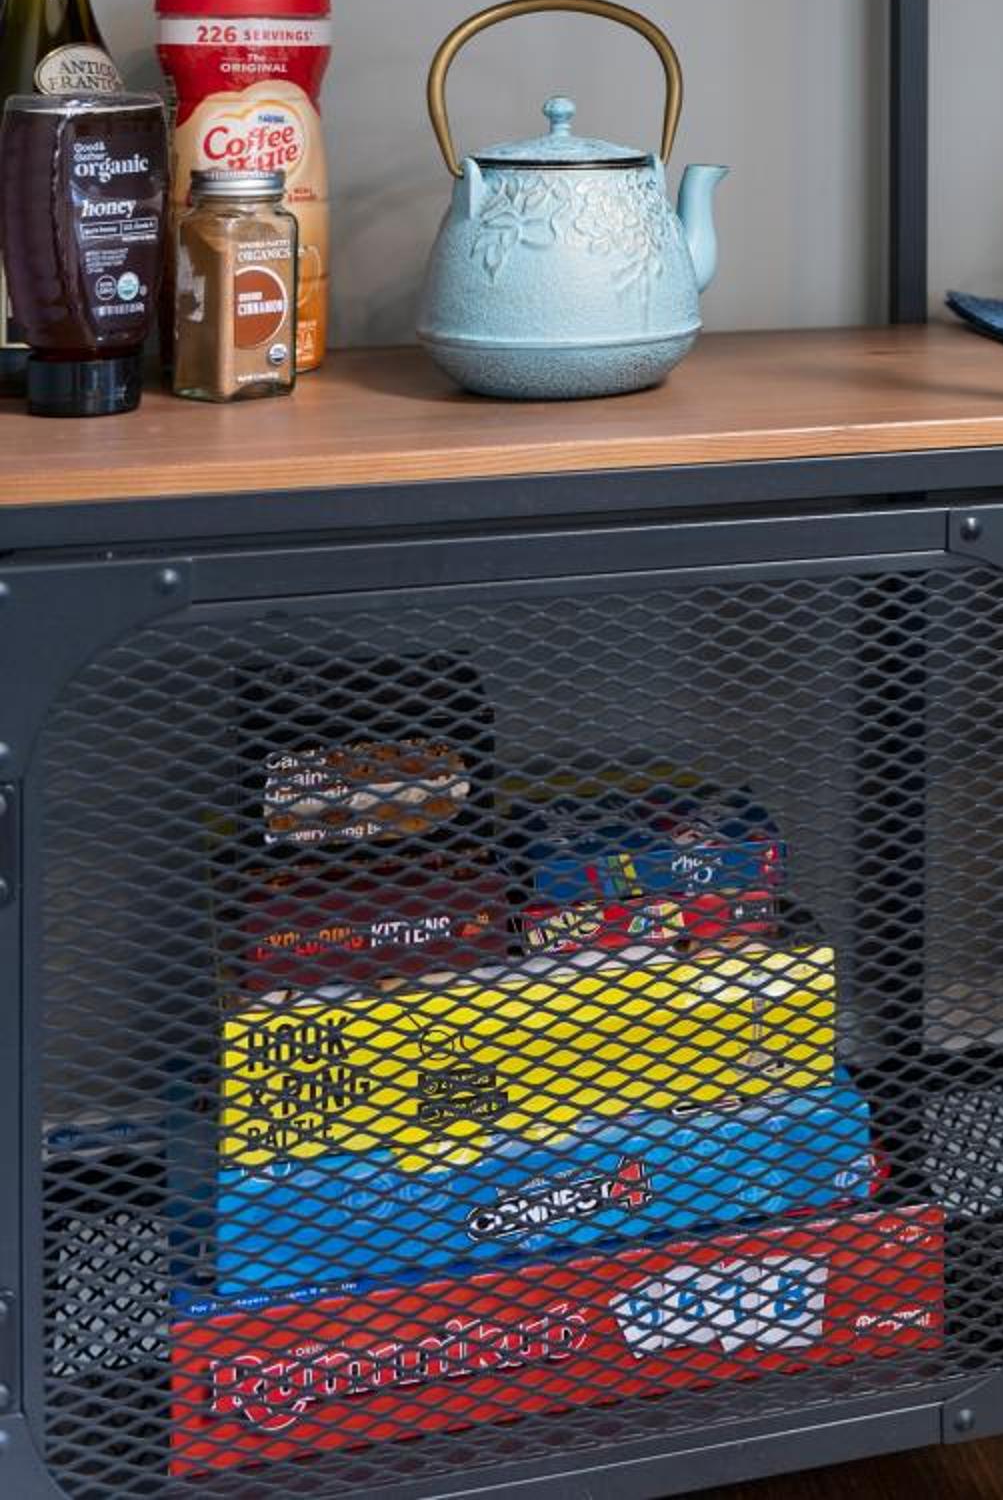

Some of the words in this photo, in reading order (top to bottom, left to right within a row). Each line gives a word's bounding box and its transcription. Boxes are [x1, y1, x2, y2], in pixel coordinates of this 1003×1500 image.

[197, 25, 238, 44] 226
[247, 52, 268, 62] The
[219, 63, 288, 74] ORIGINAL
[202, 125, 296, 162] Coffee
[74, 154, 149, 183] organic
[81, 199, 137, 218] honey
